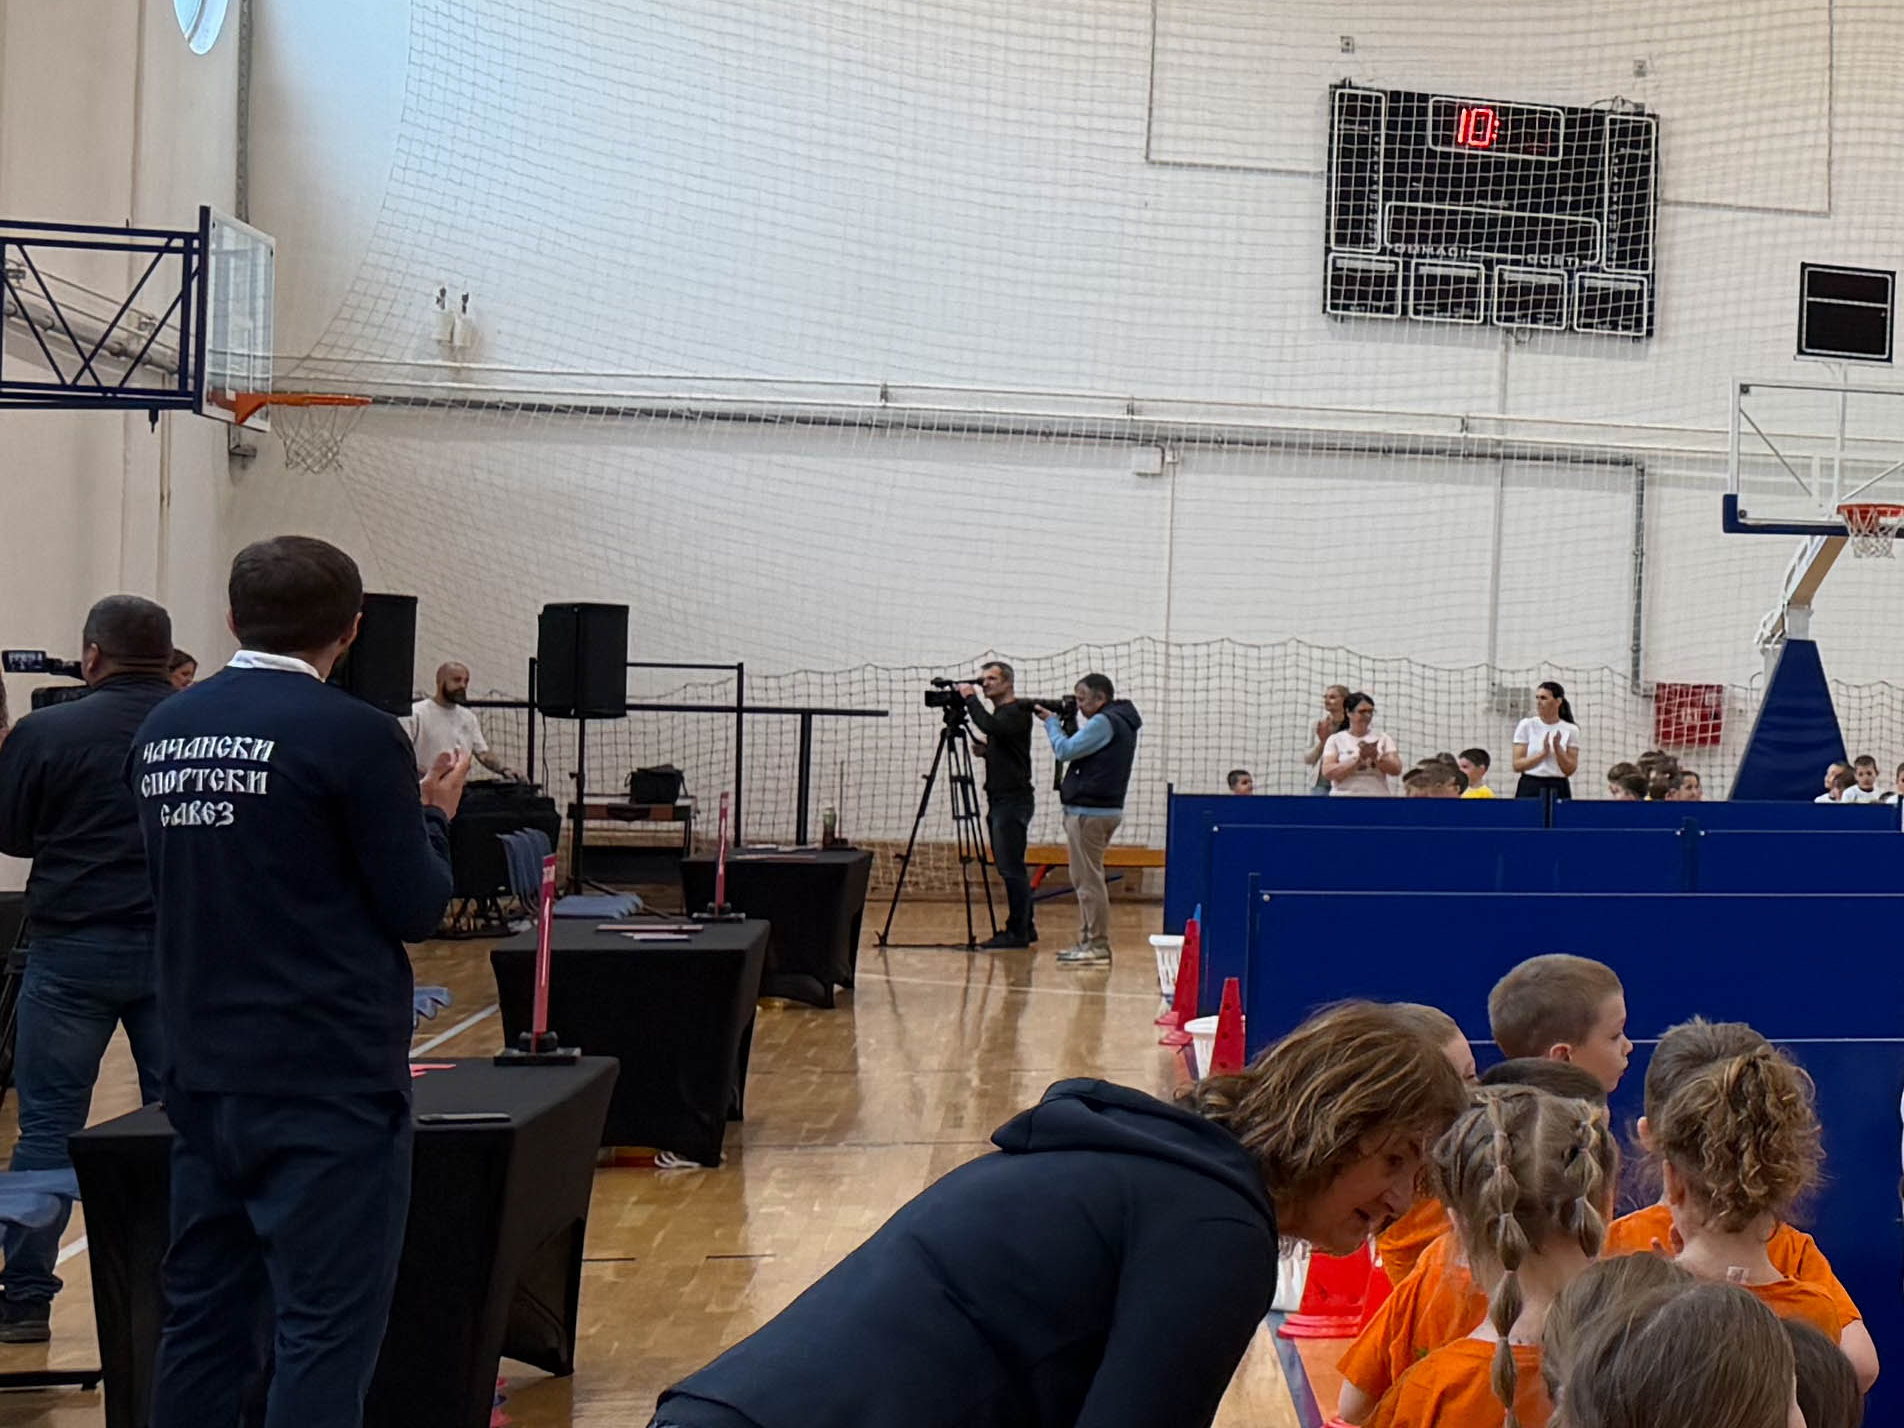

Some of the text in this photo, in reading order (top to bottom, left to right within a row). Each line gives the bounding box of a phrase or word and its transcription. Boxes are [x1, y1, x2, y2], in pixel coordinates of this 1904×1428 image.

[143, 735, 275, 764] ЧАЧАНСКИ
[141, 768, 268, 798] СПОРТСКИ
[160, 800, 235, 827] САВЕЗ
